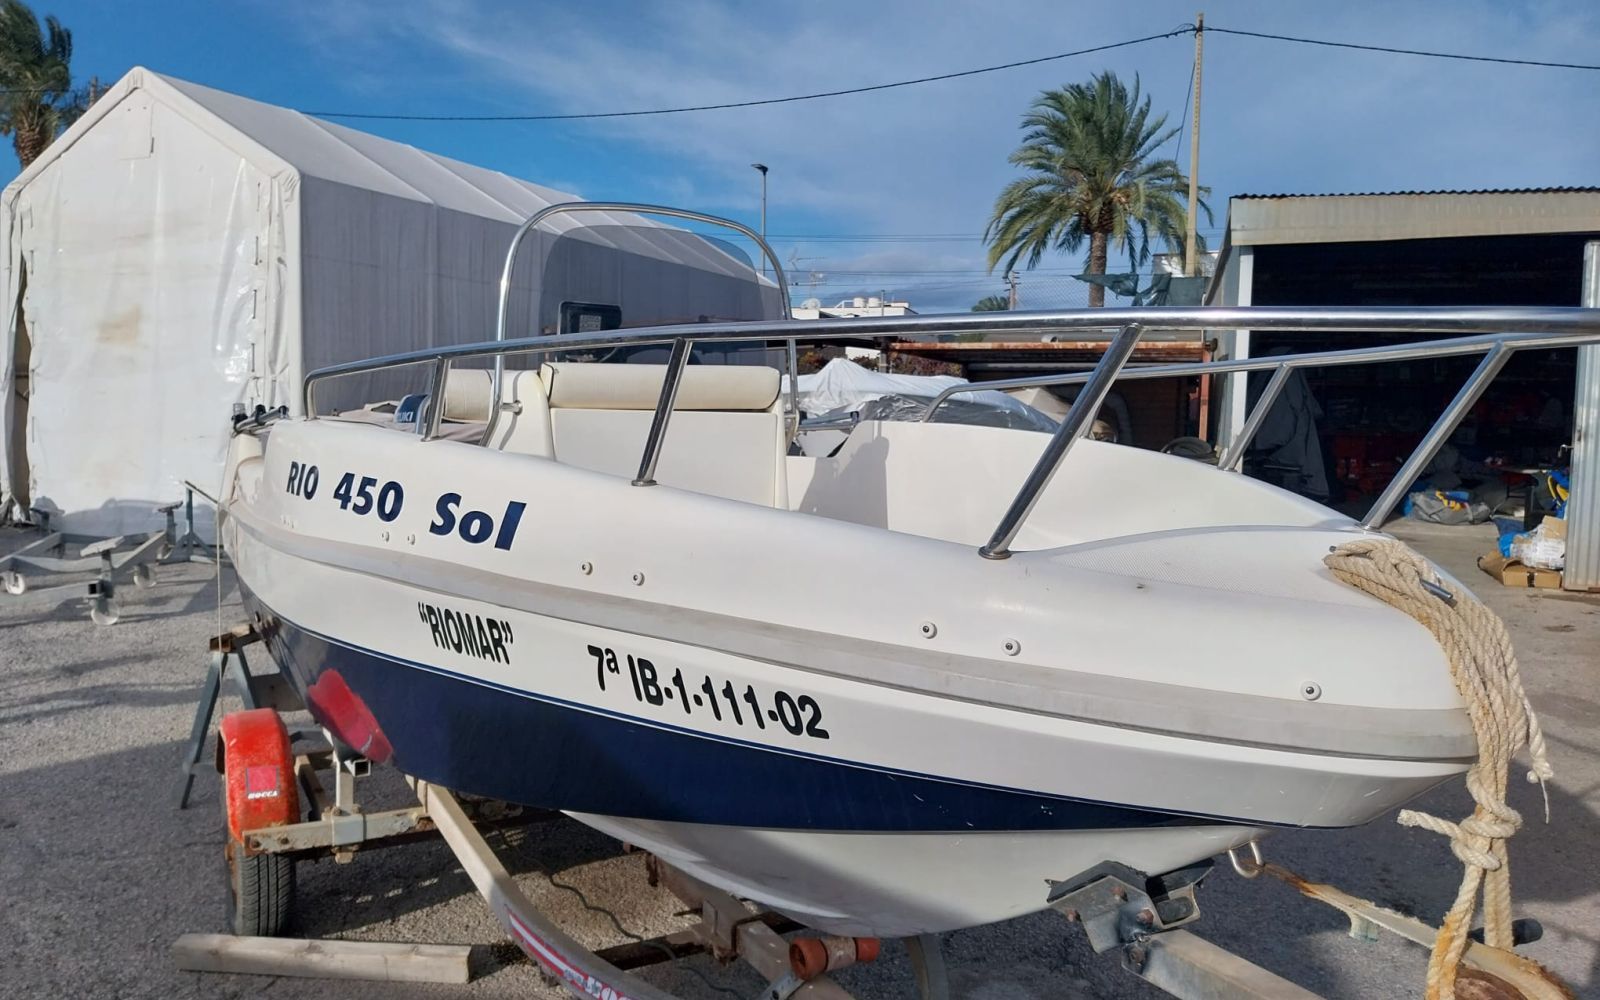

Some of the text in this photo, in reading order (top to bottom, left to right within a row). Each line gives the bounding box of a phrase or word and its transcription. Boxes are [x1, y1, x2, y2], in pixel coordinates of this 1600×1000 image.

[286, 461, 527, 551] RIO 450 Sol
